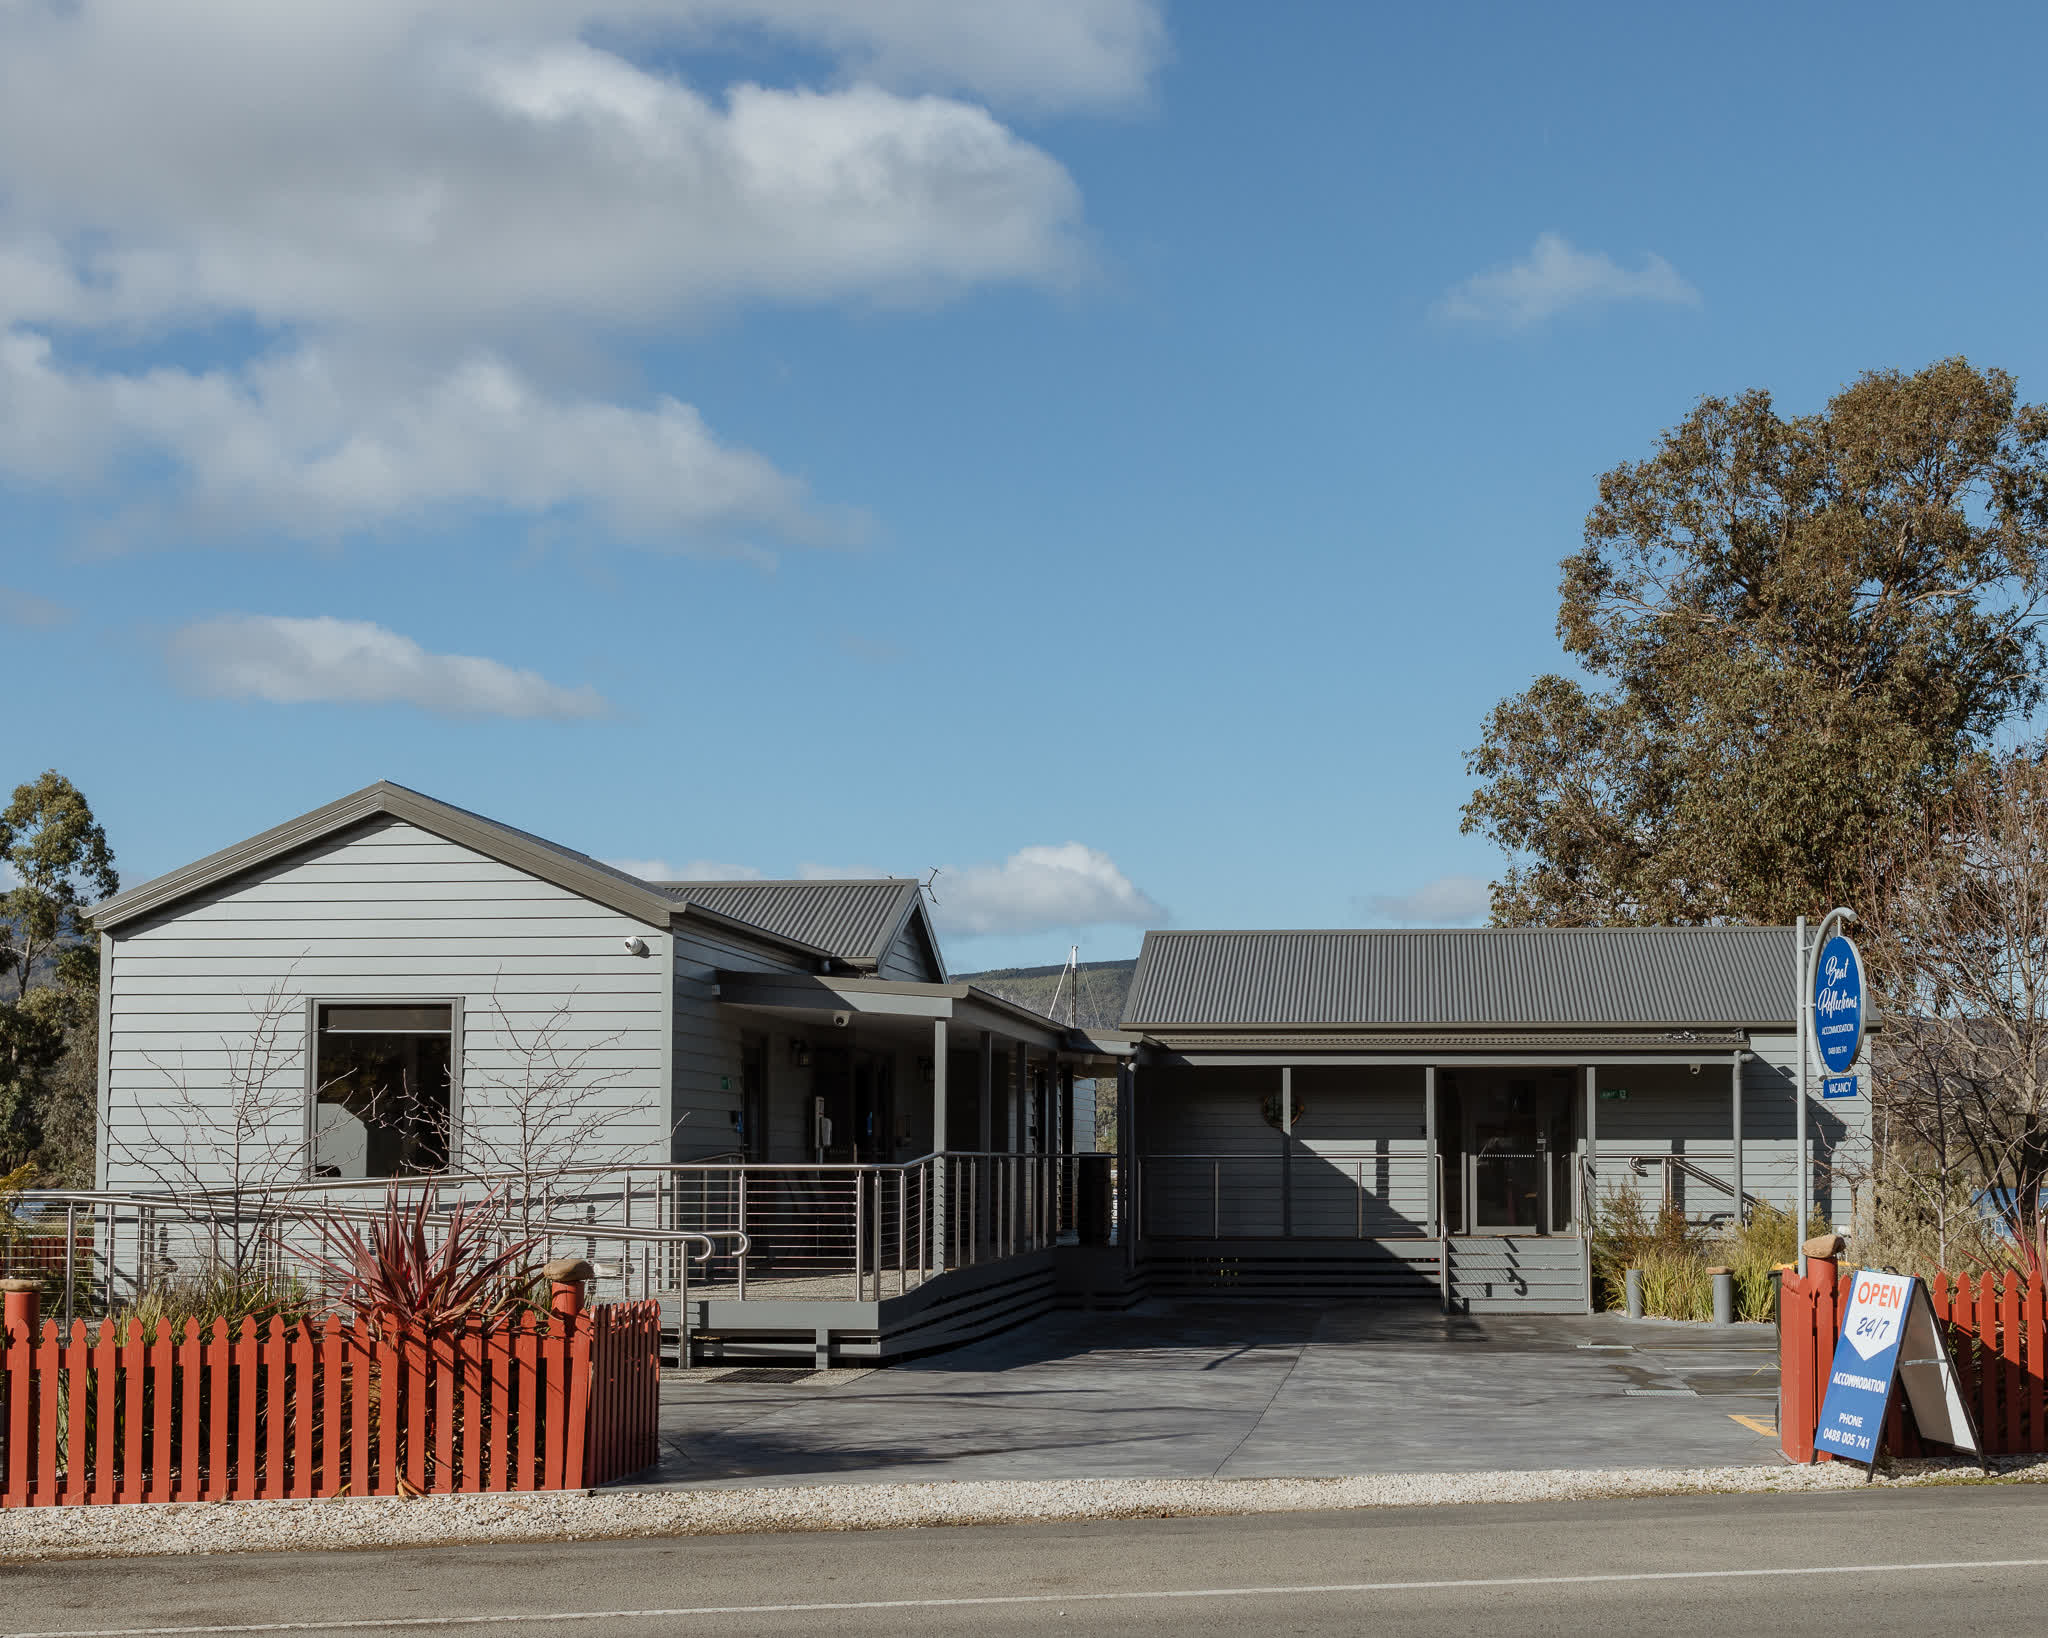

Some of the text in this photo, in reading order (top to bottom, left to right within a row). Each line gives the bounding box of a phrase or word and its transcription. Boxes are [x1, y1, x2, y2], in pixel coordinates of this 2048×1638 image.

[1826, 956, 1849, 986] Boat
[1818, 988, 1857, 1019] Reflections
[1822, 1024, 1854, 1035] ACCOMMODATION
[1829, 1081, 1851, 1094] VACANCY
[1857, 1281, 1902, 1310] OPEN
[1856, 1316, 1890, 1340] 24/7
[1833, 1371, 1886, 1394] ACCOMMODATION
[1838, 1412, 1863, 1428] PHONE
[1823, 1427, 1871, 1450] 0488 005 741
